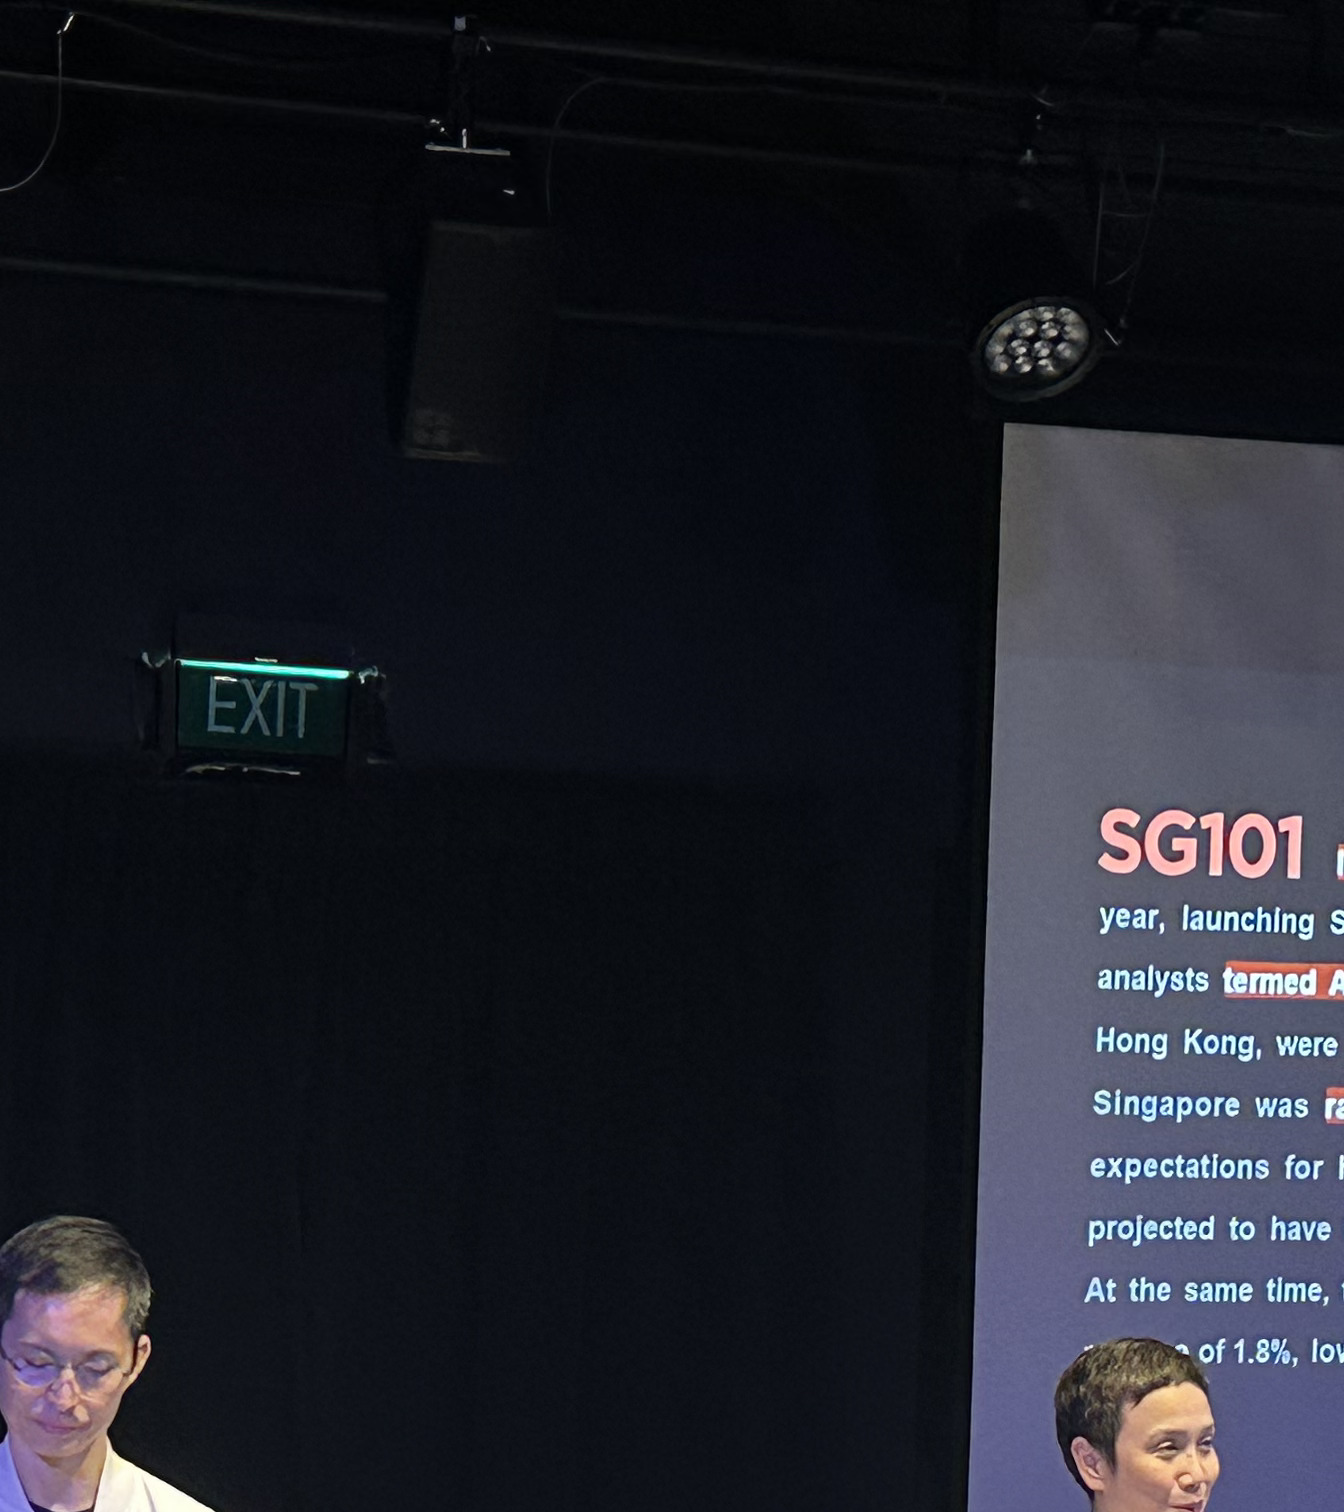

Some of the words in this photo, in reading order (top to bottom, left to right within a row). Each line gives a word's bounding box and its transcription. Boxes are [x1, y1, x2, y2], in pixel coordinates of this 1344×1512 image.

[207, 675, 319, 738] EXIT
[1097, 807, 1304, 879] SG101
[1099, 906, 1165, 935] year,
[1182, 904, 1315, 941] launching
[1097, 964, 1210, 998] analysts
[1222, 966, 1317, 997] termed
[1096, 1026, 1168, 1061] Hong
[1183, 1028, 1262, 1063] Kong,
[1275, 1035, 1339, 1057] were
[1092, 1088, 1241, 1124] Singapore
[1254, 1096, 1309, 1119] was
[1090, 1153, 1270, 1185] expectations
[1284, 1153, 1325, 1181] for
[1088, 1214, 1216, 1248] projected
[1228, 1216, 1256, 1241] to
[1270, 1215, 1332, 1242] have
[1083, 1276, 1117, 1304] At
[1128, 1276, 1172, 1303] the
[1184, 1281, 1254, 1303] same
[1266, 1276, 1330, 1307] time,
[1198, 1337, 1227, 1365] of
[1233, 1338, 1299, 1368] 1.8%,
